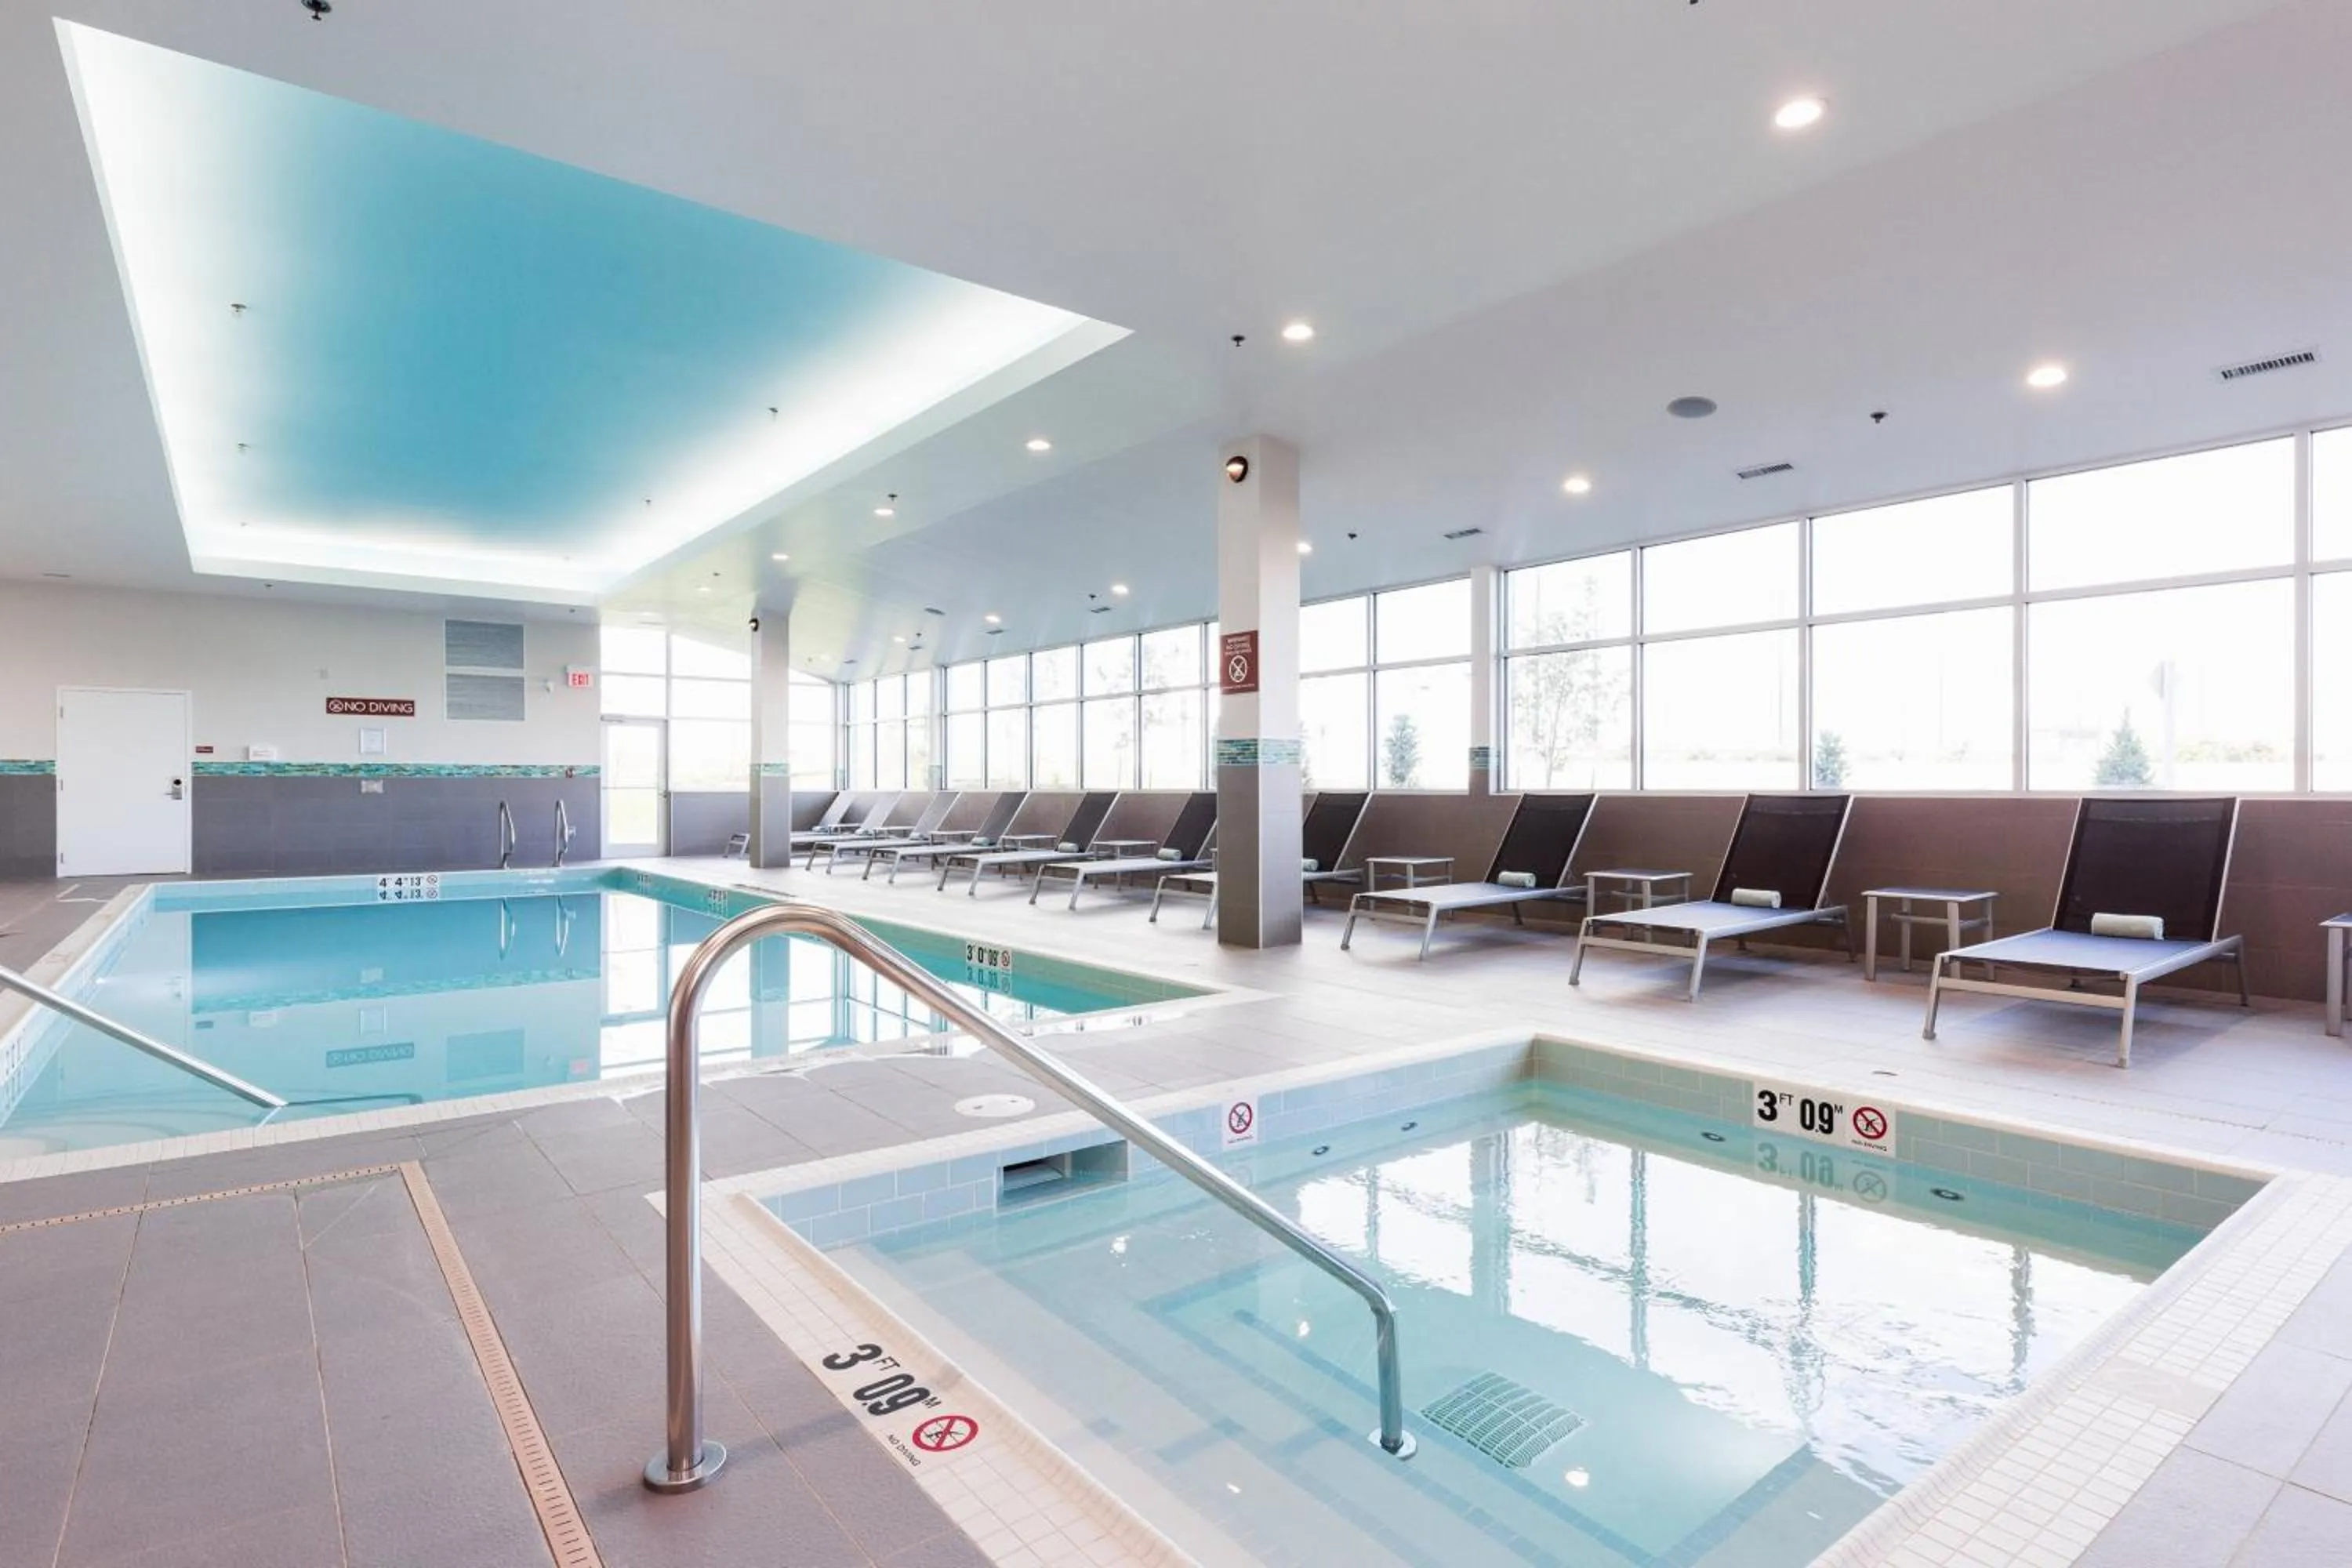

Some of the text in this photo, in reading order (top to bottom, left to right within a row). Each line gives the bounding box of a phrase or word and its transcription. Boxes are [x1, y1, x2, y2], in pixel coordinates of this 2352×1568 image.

[572, 673, 589, 685] EXIT
[345, 702, 413, 713] NO DIVING
[887, 1434, 921, 1467] NO DIVING
